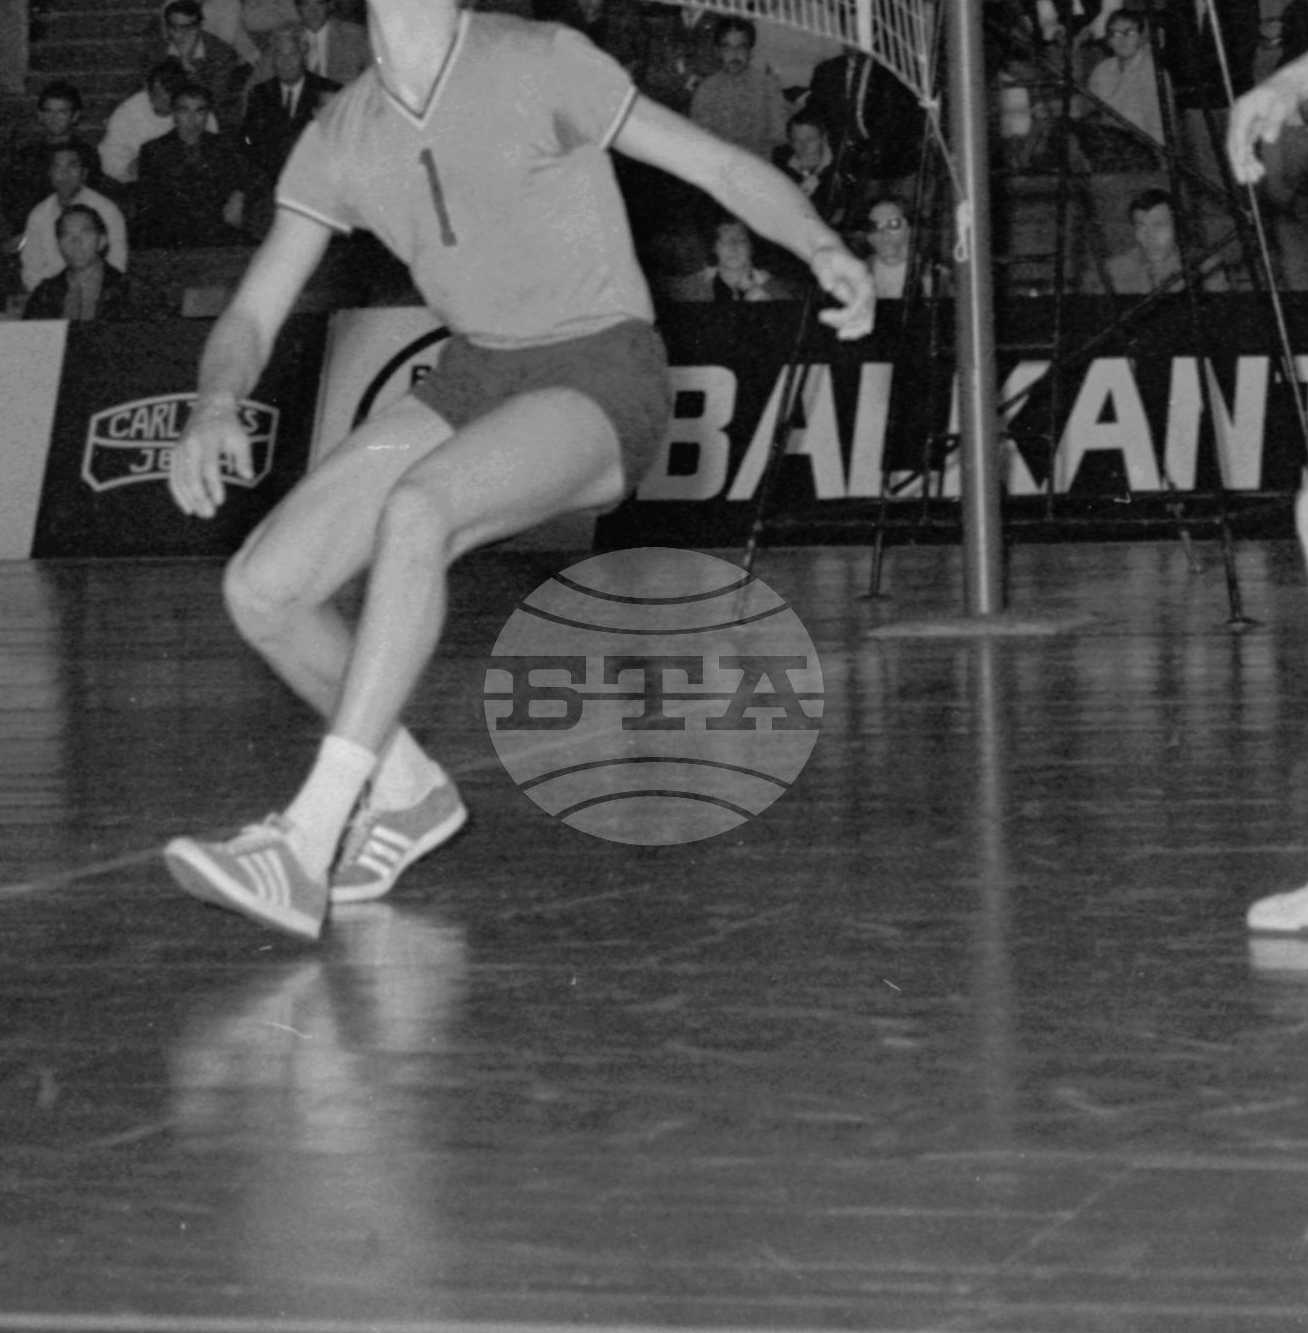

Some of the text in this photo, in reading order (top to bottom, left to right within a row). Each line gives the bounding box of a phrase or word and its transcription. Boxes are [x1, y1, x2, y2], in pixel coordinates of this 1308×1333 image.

[419, 148, 457, 246] 1
[109, 402, 180, 438] CARL
[129, 448, 237, 475] JEA
